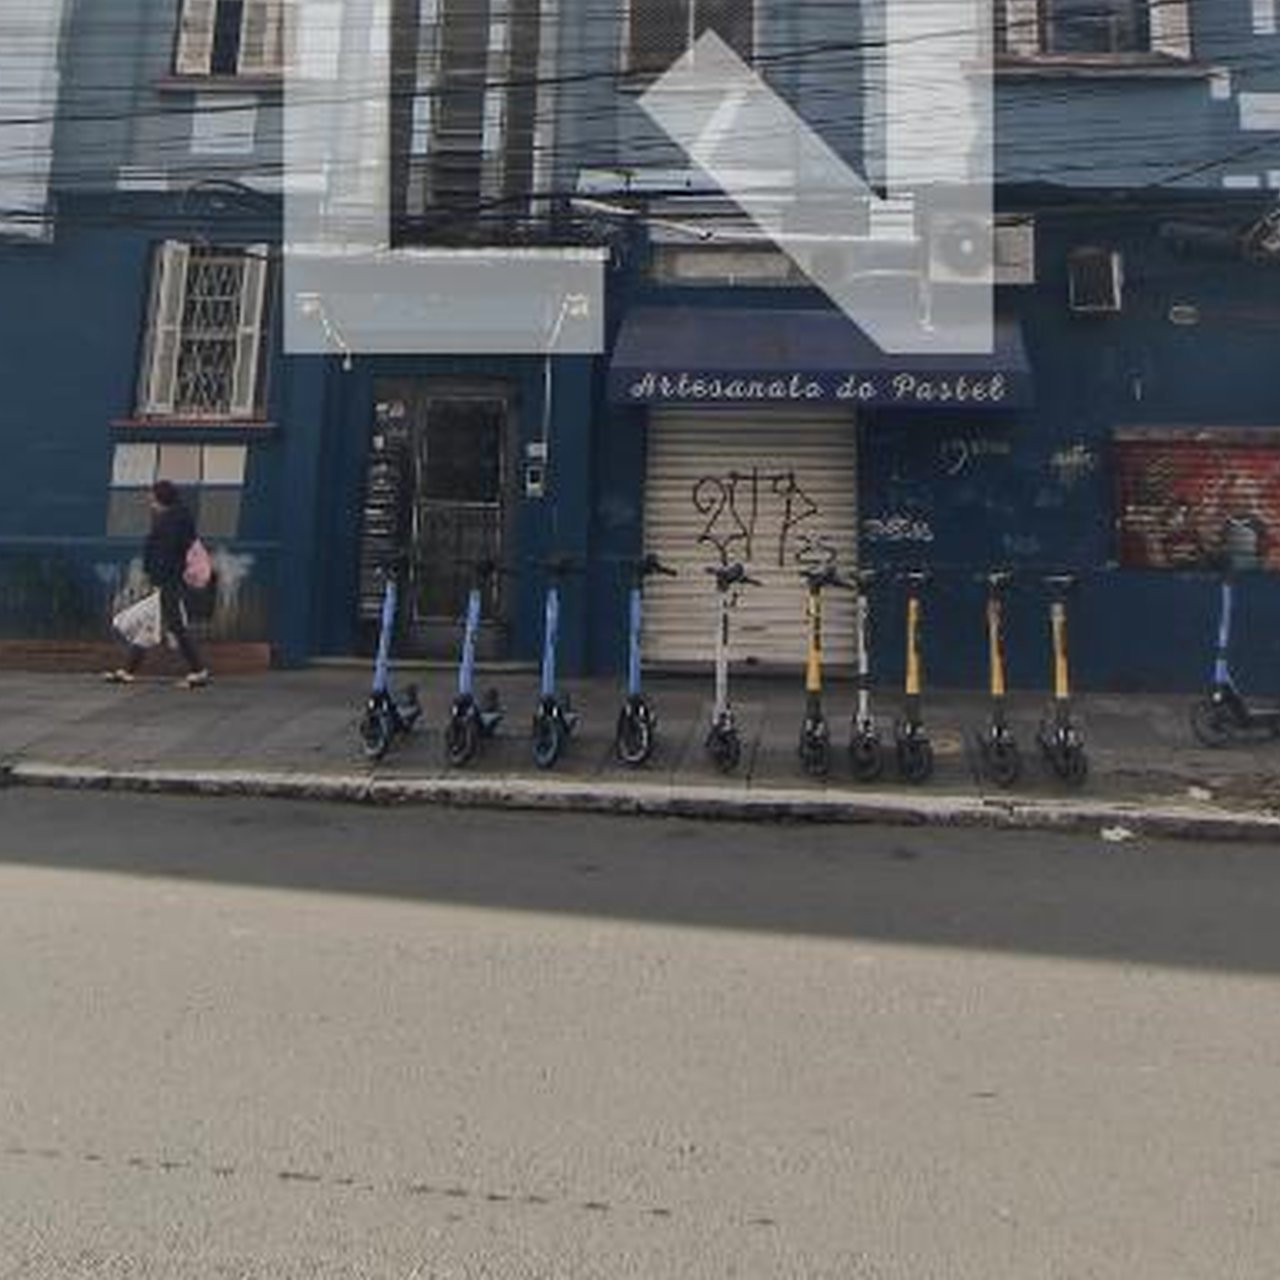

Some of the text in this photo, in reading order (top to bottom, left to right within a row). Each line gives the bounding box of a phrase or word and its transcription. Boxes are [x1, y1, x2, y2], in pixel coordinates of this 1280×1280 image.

[629, 371, 1007, 401] Artesanato do Pastel
